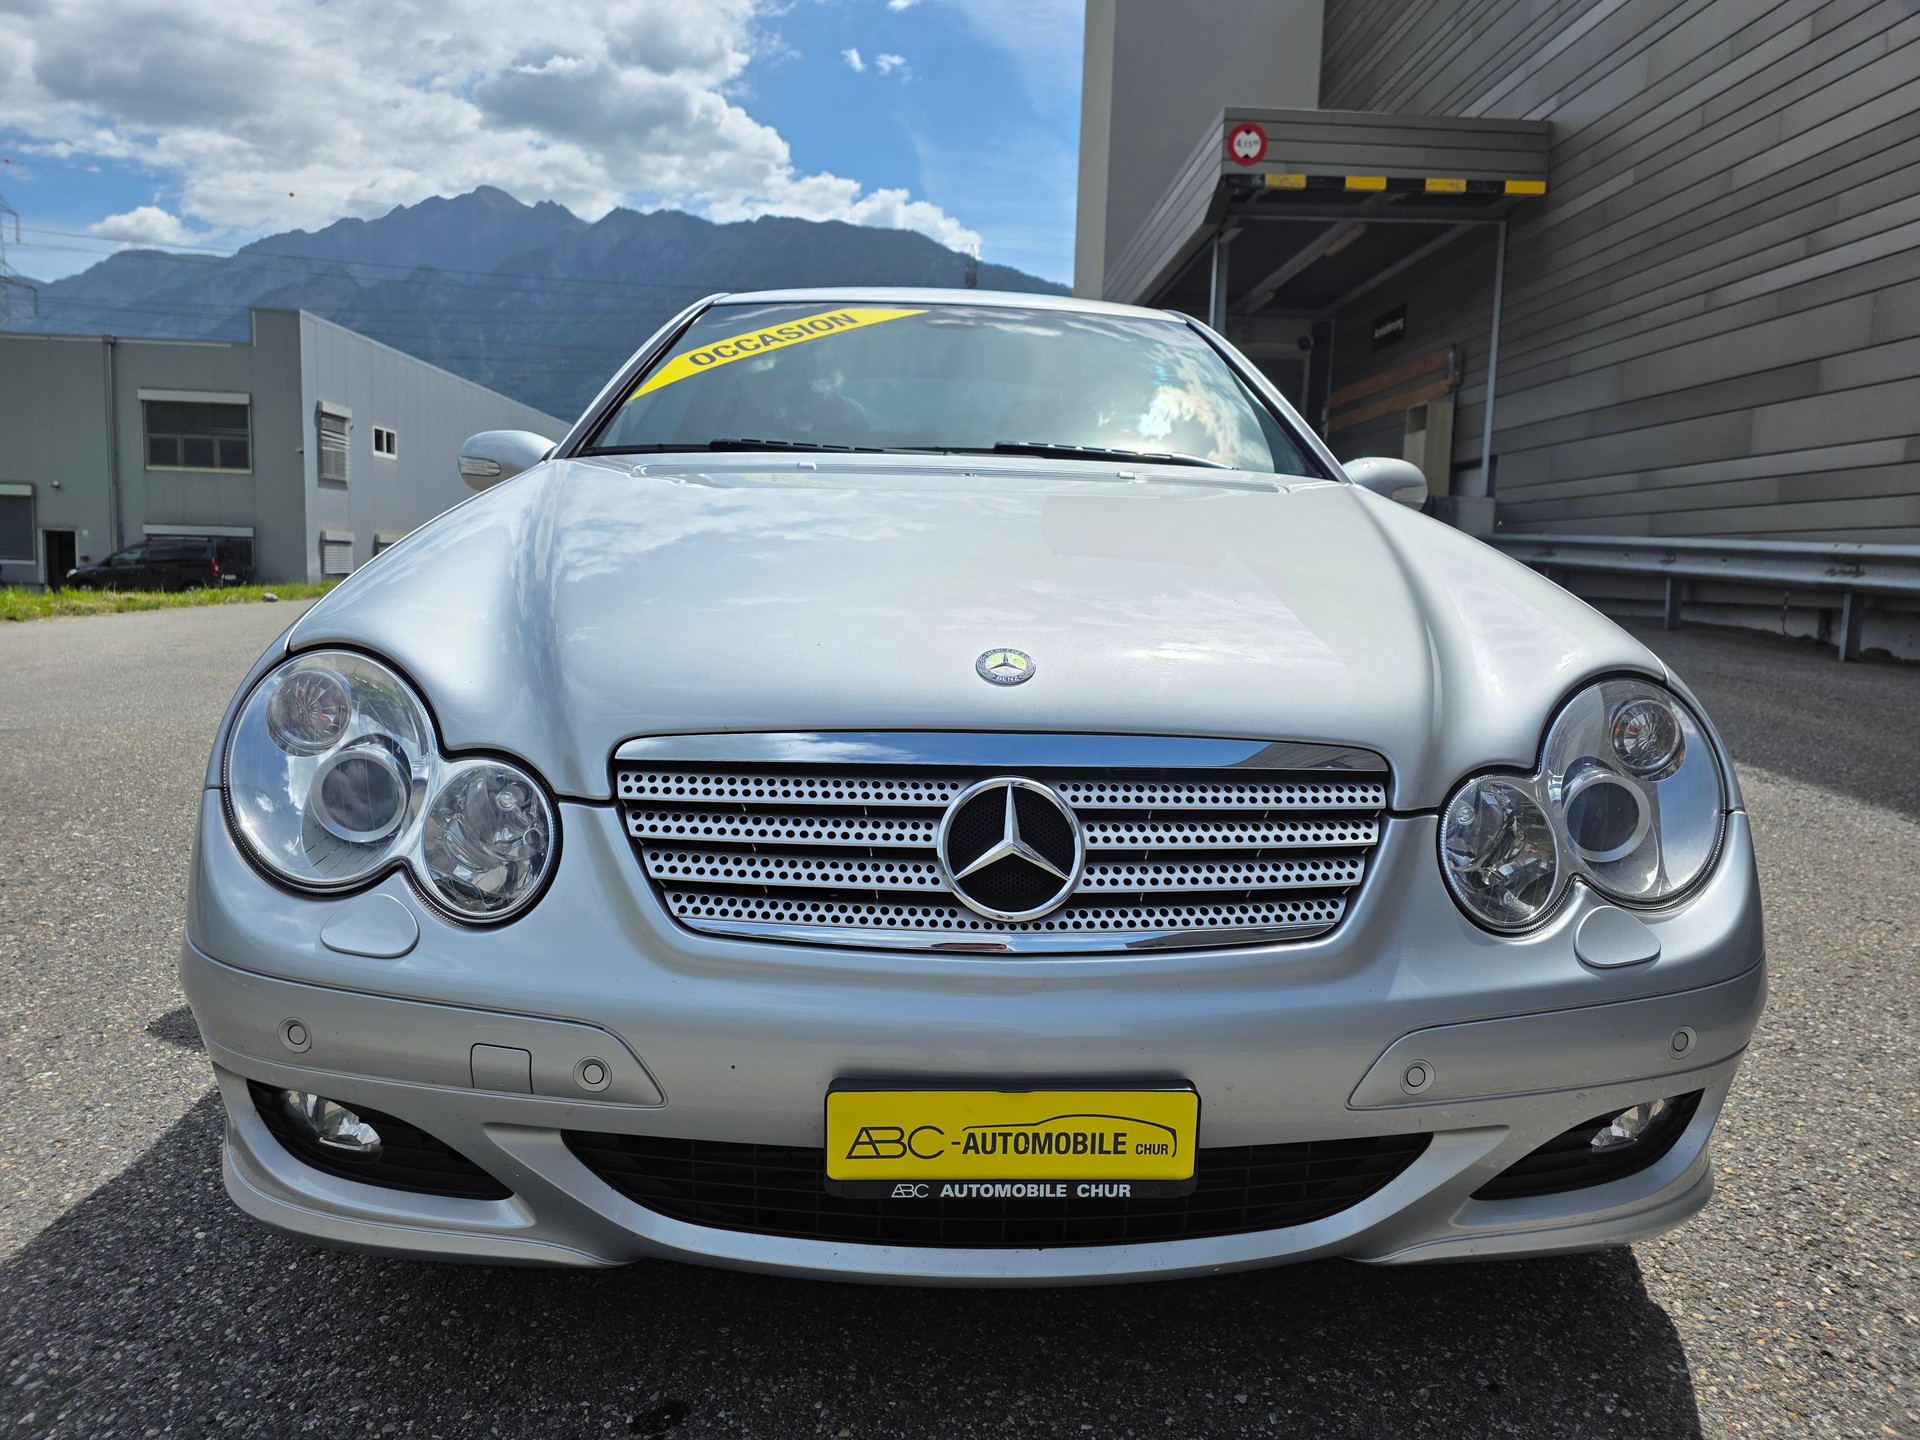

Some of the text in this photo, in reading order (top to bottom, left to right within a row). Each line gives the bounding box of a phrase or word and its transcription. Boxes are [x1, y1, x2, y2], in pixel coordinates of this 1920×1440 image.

[688, 313, 859, 366] OCCASION
[845, 1125, 945, 1160] ABC
[1135, 1143, 1169, 1156] CHUR
[891, 1183, 1131, 1199] ABC AUTOMOBILE CHUR
